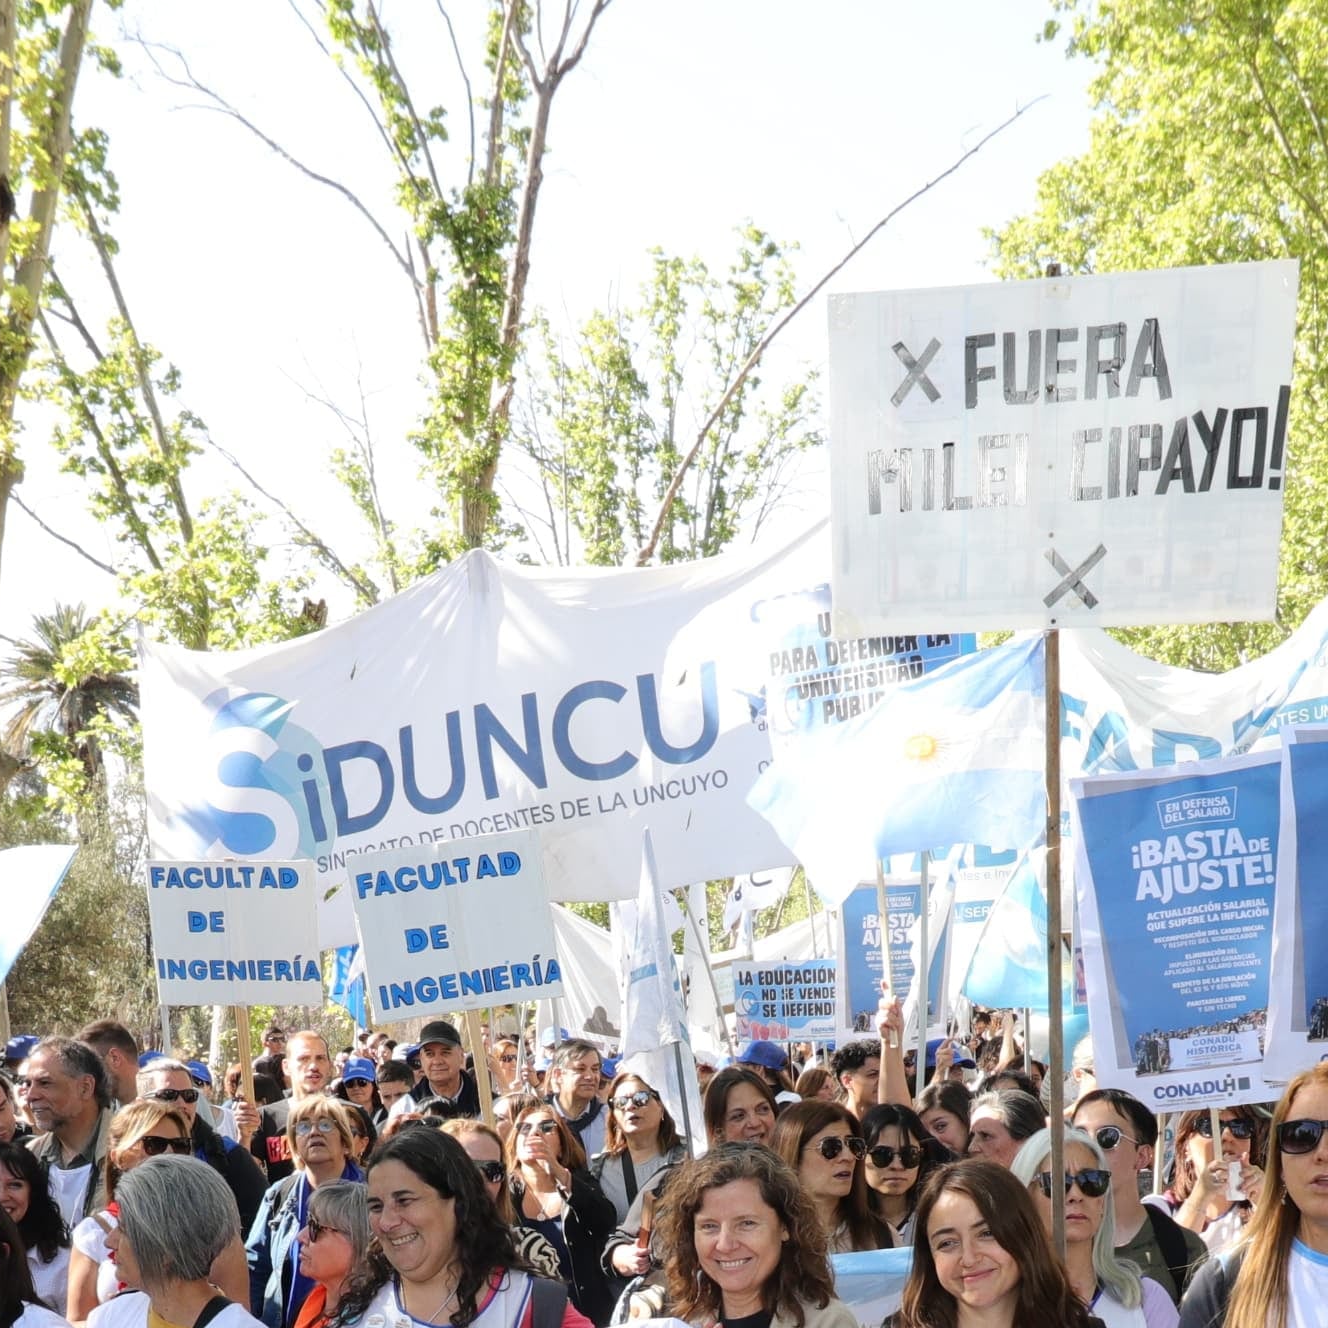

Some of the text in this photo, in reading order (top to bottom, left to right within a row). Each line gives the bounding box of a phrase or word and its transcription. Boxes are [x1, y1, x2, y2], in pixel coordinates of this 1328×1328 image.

[964, 317, 1173, 409] FUERA
[866, 384, 1292, 516] MILEI CIPAYO!
[769, 633, 951, 677] PARA DEFENDER LA
[450, 803, 556, 841] DOCENTES
[560, 797, 591, 820] DE
[597, 790, 628, 814] LA
[632, 769, 729, 807] UNCUYO
[1164, 806, 1232, 824] DEL SALARIO
[1165, 796, 1229, 814] EN DEFENSA
[1131, 828, 1271, 869] ¡BASTA DE
[150, 866, 299, 890] FACULTAD
[355, 850, 522, 900] FACULTAD
[1135, 853, 1275, 905] AJUSTE!
[187, 910, 225, 933] DE
[862, 912, 916, 929] ¡BSTA
[1146, 898, 1267, 921] ACTUALIZACIÓN SALARIAL
[1146, 907, 1269, 932] QUE SUPERE LA INFLACIÓN
[404, 923, 449, 954] DE
[158, 954, 321, 983] INGENIERÍA
[738, 965, 836, 986] LA EDUCACIÓN
[378, 954, 564, 1011] INGENIERÍA
[761, 986, 836, 1001] NO SE VENDE
[762, 1002, 836, 1018] SE DEFIEND
[1192, 1035, 1236, 1047] CONADU
